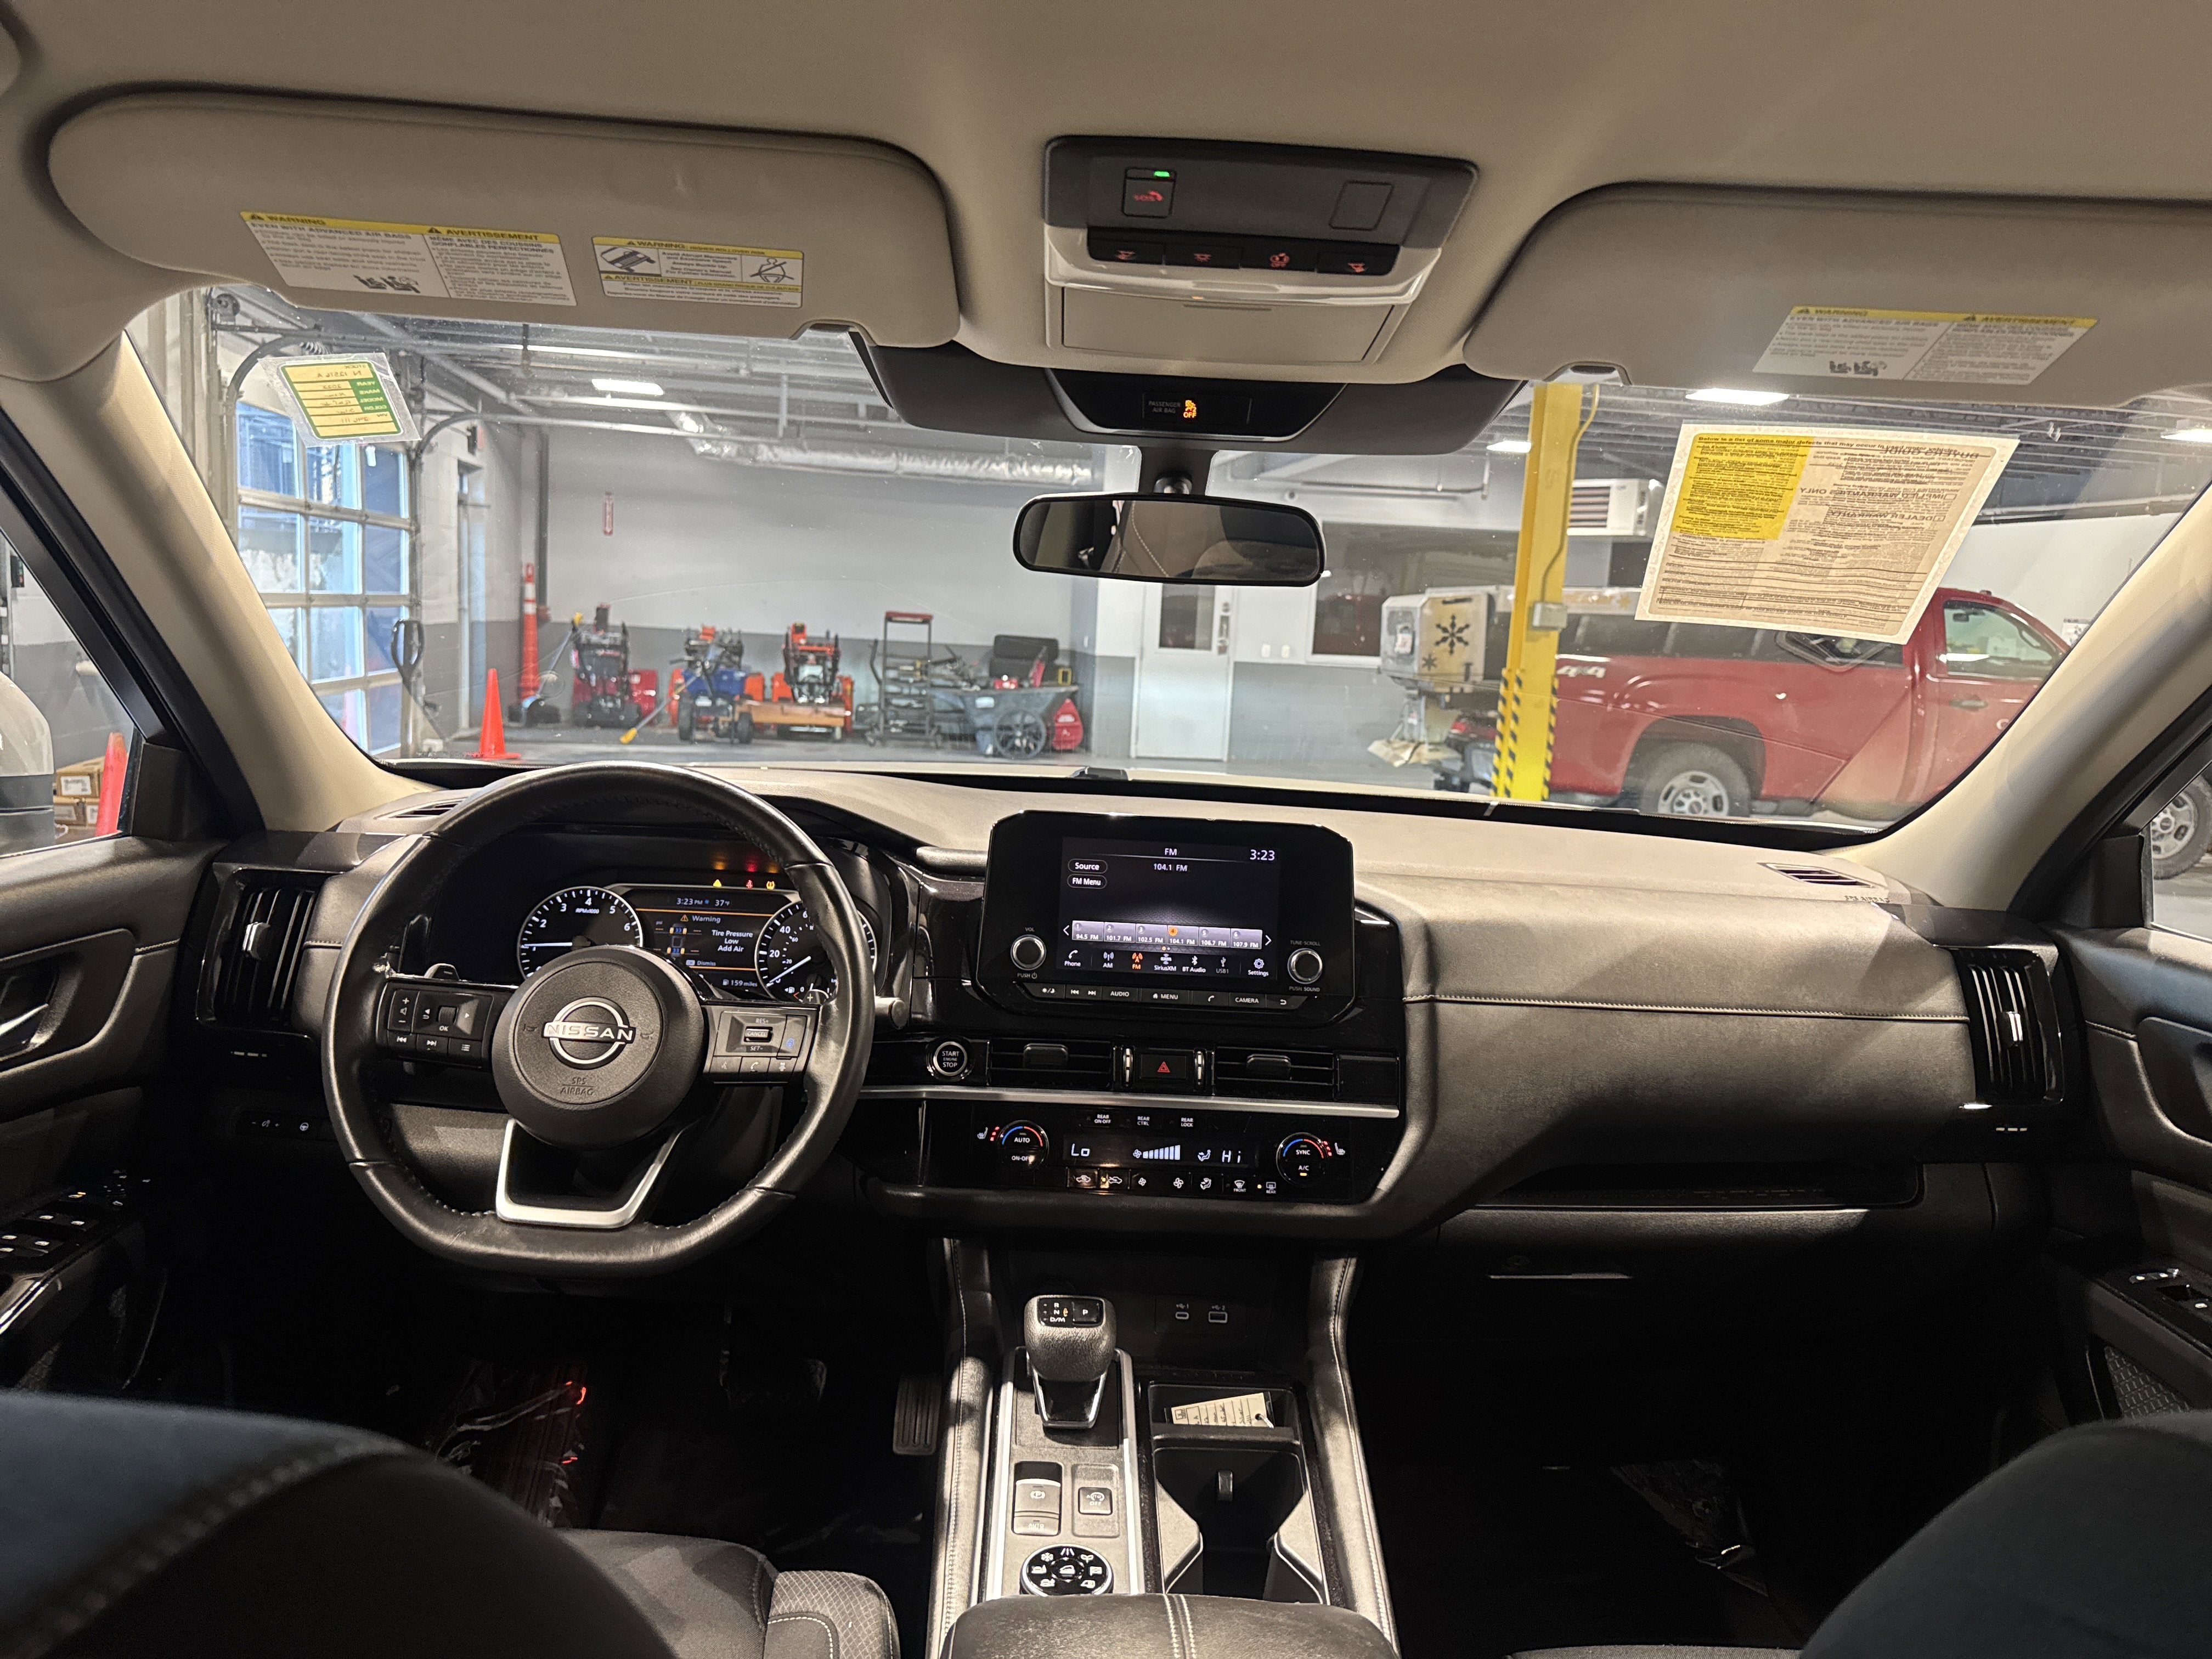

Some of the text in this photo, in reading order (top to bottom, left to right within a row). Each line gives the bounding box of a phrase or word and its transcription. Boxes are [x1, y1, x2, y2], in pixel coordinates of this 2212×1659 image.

[267, 215, 326, 225] WARNING
[447, 229, 539, 241] AVERTISSEMENT
[614, 275, 693, 285] AVERTISSEMENT
[1165, 848, 1275, 861] FM 3:23
[1075, 862, 1100, 871] Source
[1153, 863, 1188, 872] 104.1 FM
[1083, 878, 1101, 887] Menu
[585, 898, 592, 906] 4
[560, 903, 567, 912] 3
[609, 906, 616, 914] 5
[540, 919, 547, 928] 2
[692, 915, 721, 924] Warning
[624, 922, 630, 932] 6
[769, 950, 780, 958] 20
[546, 1023, 633, 1041] NISSAN
[572, 1077, 586, 1085] SRS
[560, 1086, 594, 1097] AIRBAG
[1071, 1143, 1090, 1157] Lo
[1221, 1150, 1242, 1164] Hi
